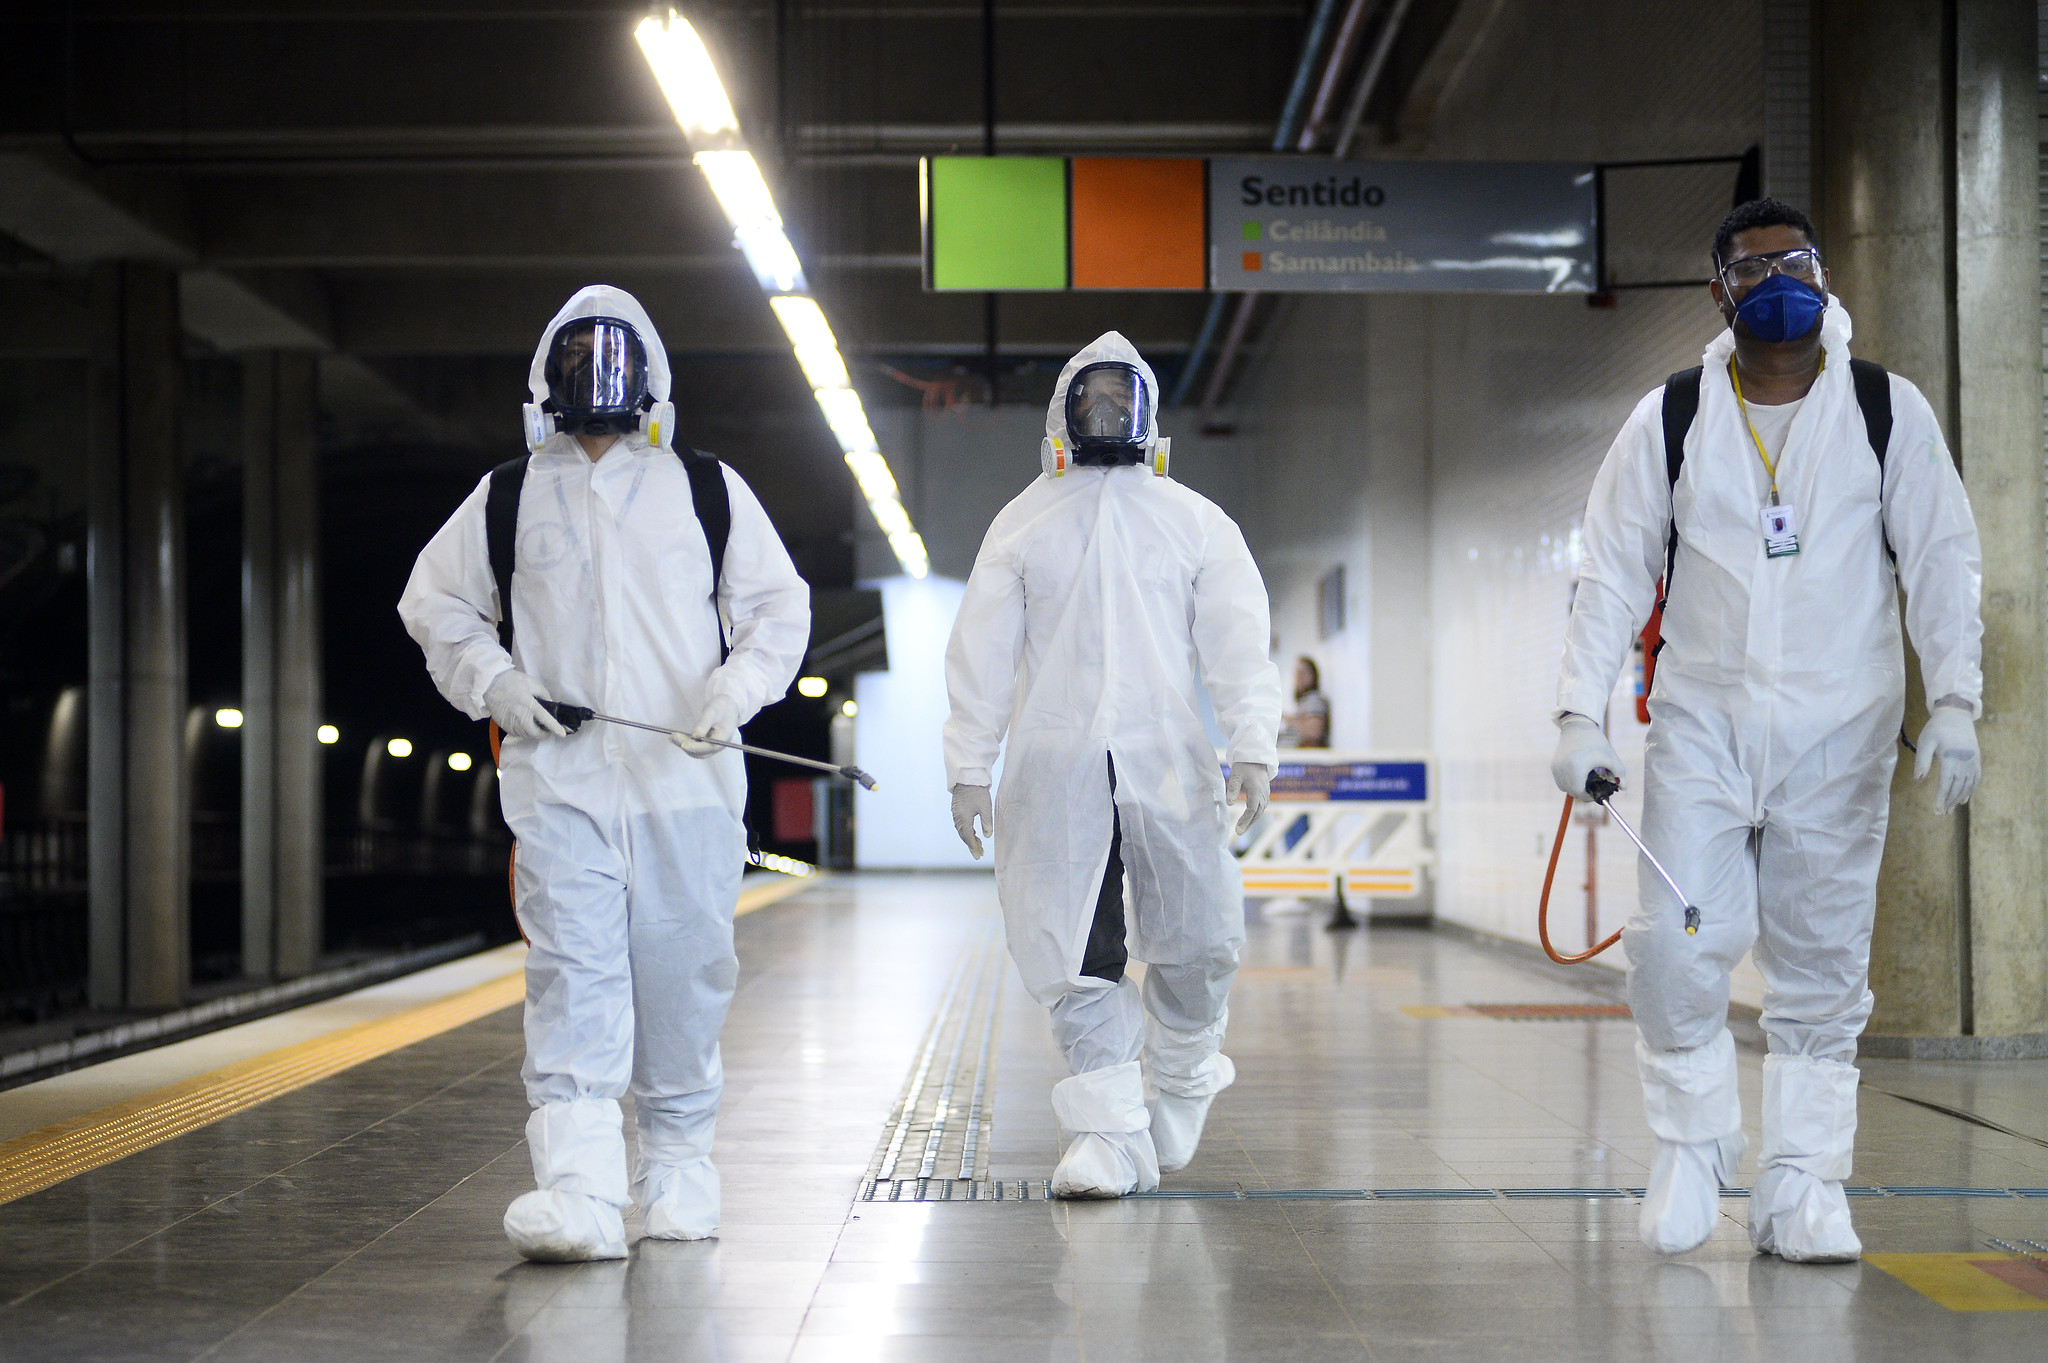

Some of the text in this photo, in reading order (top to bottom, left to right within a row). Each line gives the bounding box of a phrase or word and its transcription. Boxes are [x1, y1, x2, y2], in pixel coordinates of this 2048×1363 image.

[1241, 175, 1386, 207] Sentido
[1268, 218, 1387, 242] Ceilândia
[1268, 250, 1417, 274] Samambaia
